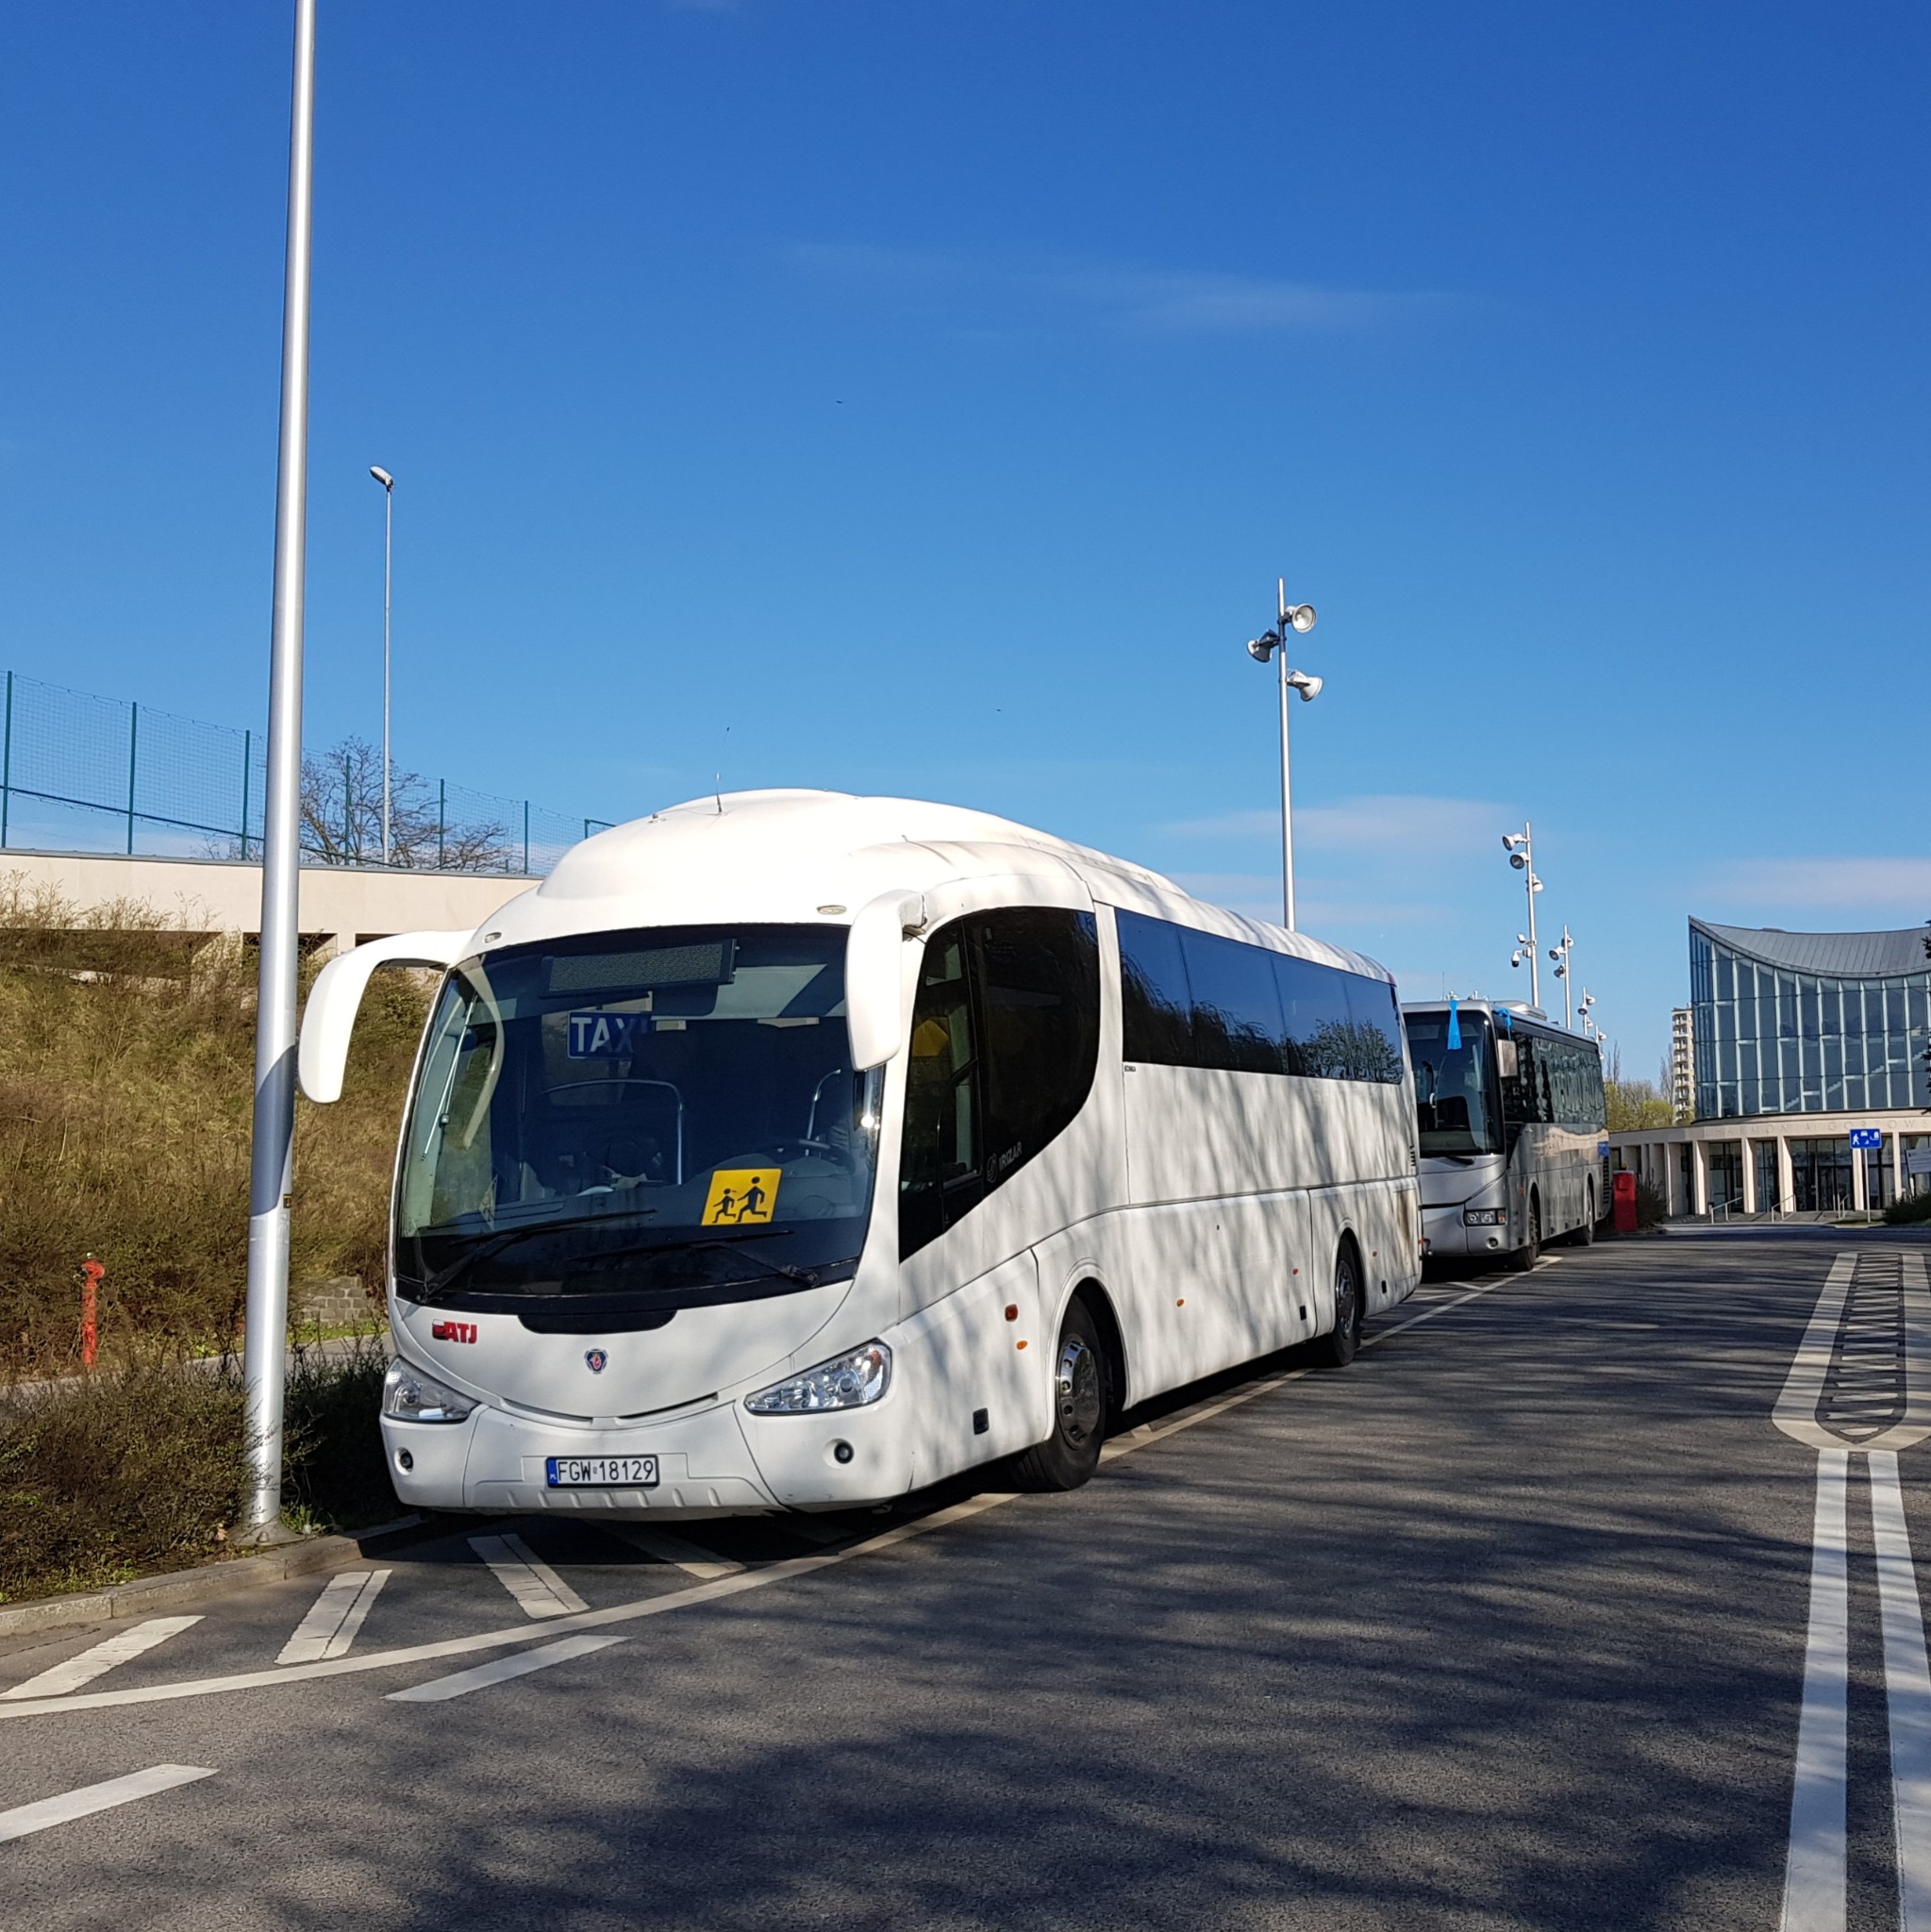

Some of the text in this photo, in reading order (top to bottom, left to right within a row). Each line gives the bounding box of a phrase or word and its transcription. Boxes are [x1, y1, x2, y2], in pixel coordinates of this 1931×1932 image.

[998, 1141, 1023, 1172] IRIZAR
[444, 1321, 478, 1344] ATJ
[557, 1460, 591, 1482] FGW
[598, 1459, 654, 1482] 18129
